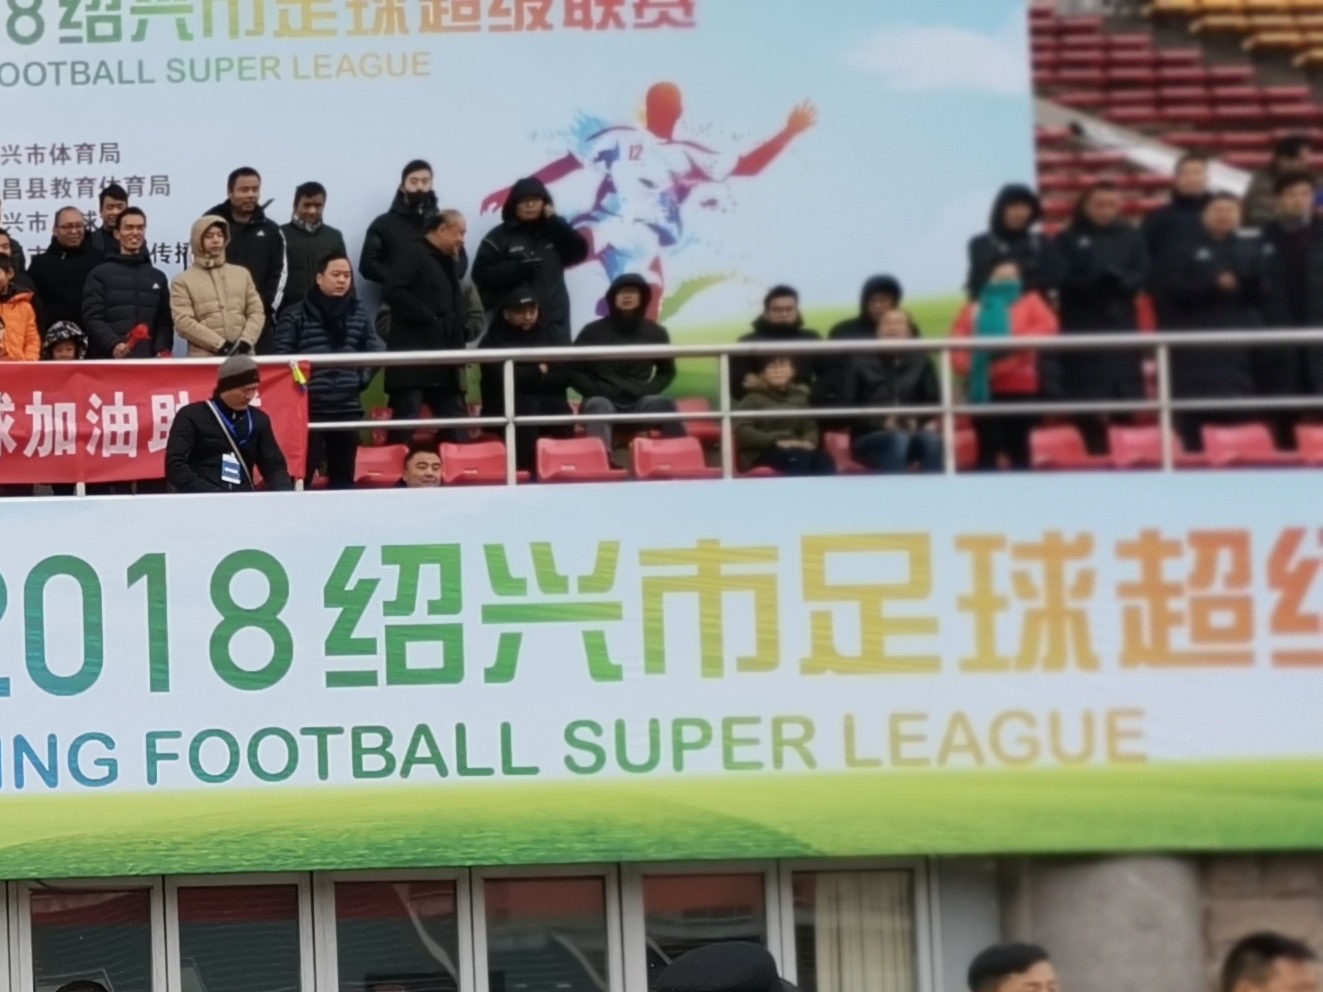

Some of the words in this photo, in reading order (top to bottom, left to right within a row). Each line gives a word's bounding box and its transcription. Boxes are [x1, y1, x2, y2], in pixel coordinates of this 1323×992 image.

[165, 54, 282, 84] SUPER
[291, 50, 433, 81] LEAGUE
[144, 720, 540, 786] FOOTBALL
[561, 714, 817, 777] SUPER
[843, 706, 1148, 770] LEAGUE
